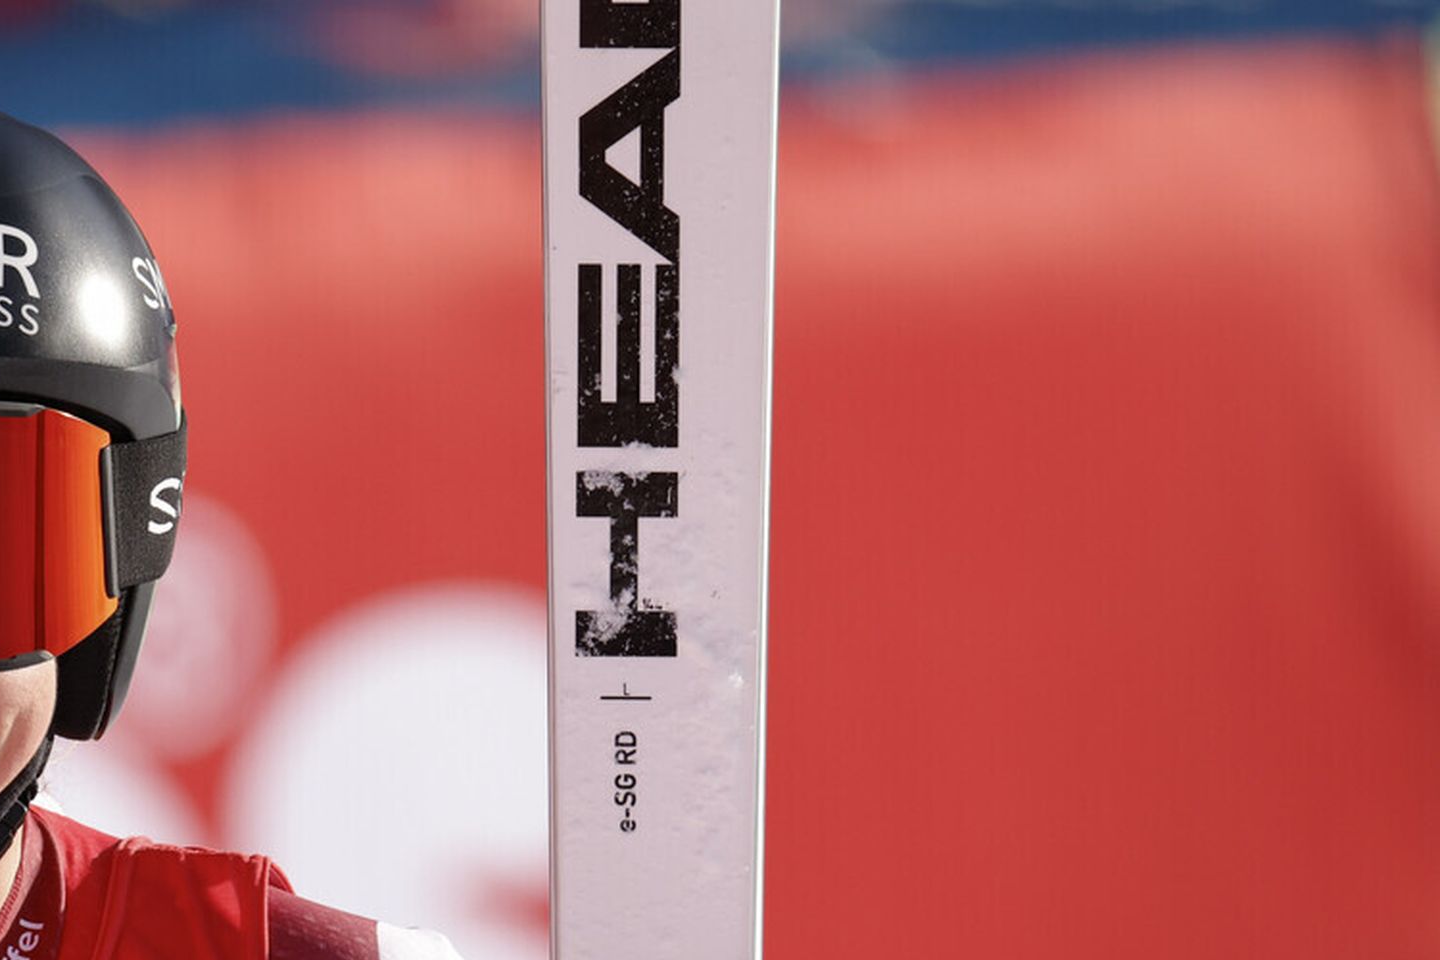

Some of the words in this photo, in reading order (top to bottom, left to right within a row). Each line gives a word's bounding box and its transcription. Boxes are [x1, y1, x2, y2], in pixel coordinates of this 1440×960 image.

[575, 0, 681, 657] HEA
[614, 730, 638, 765] RD
[614, 773, 638, 833] e-SG
